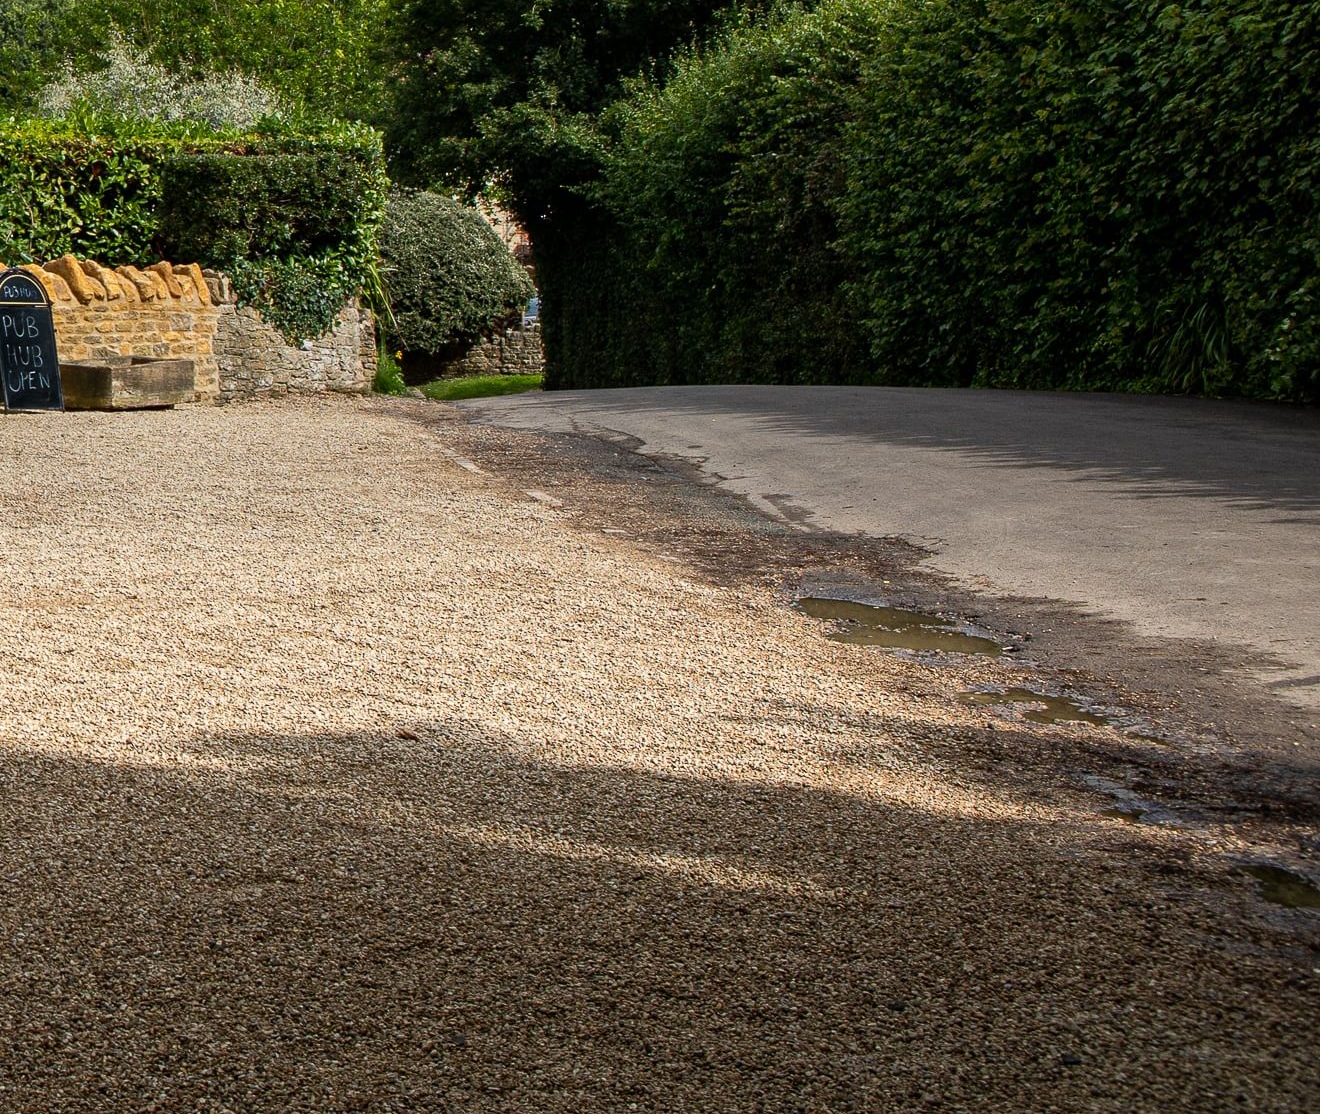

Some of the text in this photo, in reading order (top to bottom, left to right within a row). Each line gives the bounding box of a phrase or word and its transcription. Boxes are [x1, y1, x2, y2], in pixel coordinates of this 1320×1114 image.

[2, 313, 39, 338] PUB
[6, 344, 43, 368] HUB
[8, 371, 50, 393] OPEN
